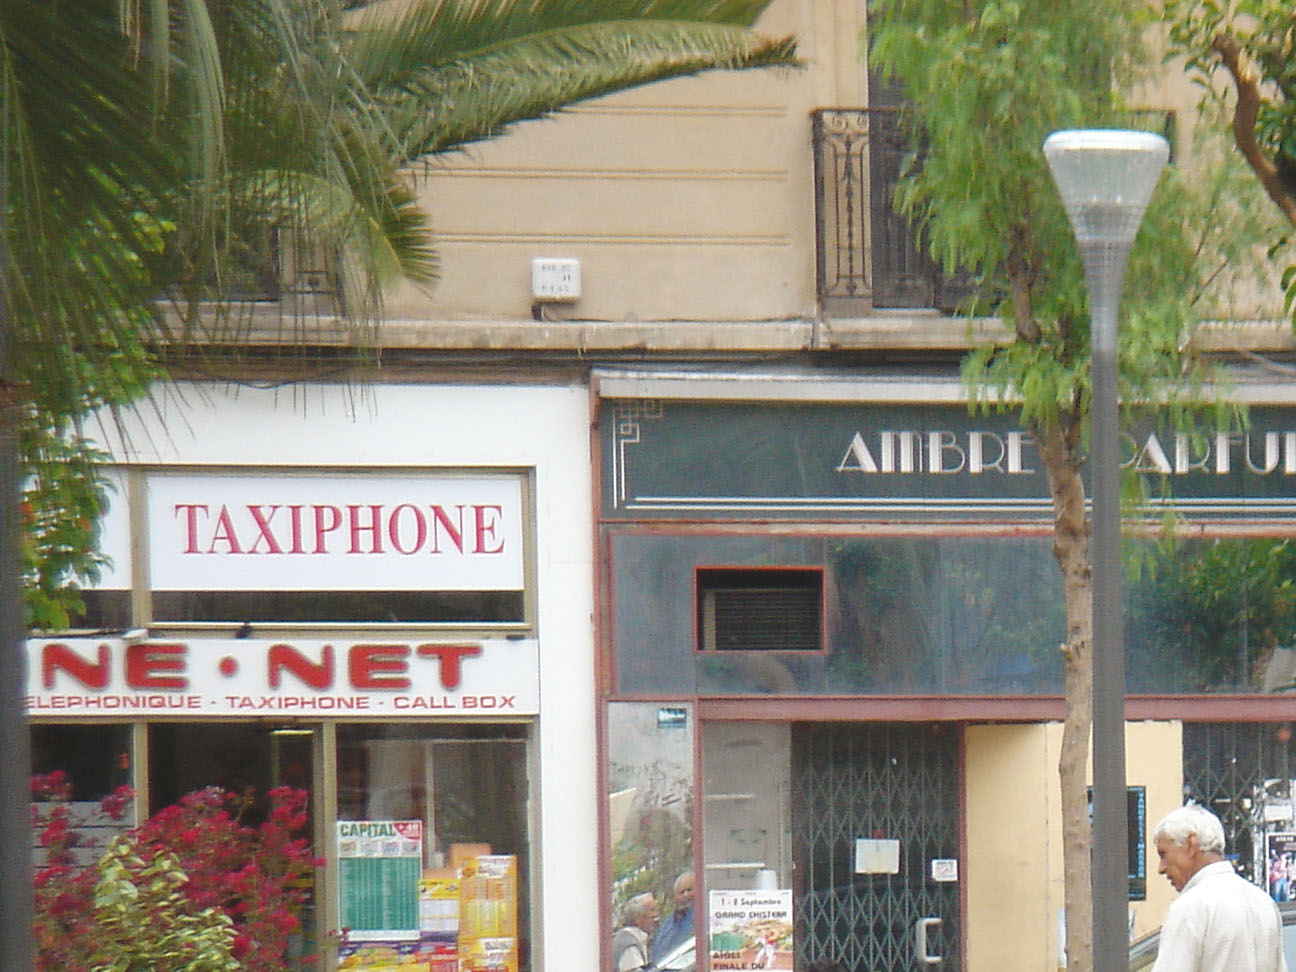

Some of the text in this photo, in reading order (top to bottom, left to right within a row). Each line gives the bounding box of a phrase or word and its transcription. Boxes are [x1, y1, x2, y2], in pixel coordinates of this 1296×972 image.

[835, 431, 1036, 474] AMBRE
[174, 503, 505, 555] TAXIPHONE
[268, 643, 484, 690] NET
[225, 696, 370, 709] TAXIPHONE
[394, 696, 455, 709] CALL
[462, 696, 516, 709] BOX
[340, 823, 396, 838] CAPITAL
[715, 911, 746, 919] GRAND
[713, 962, 766, 970] FINALE DU
